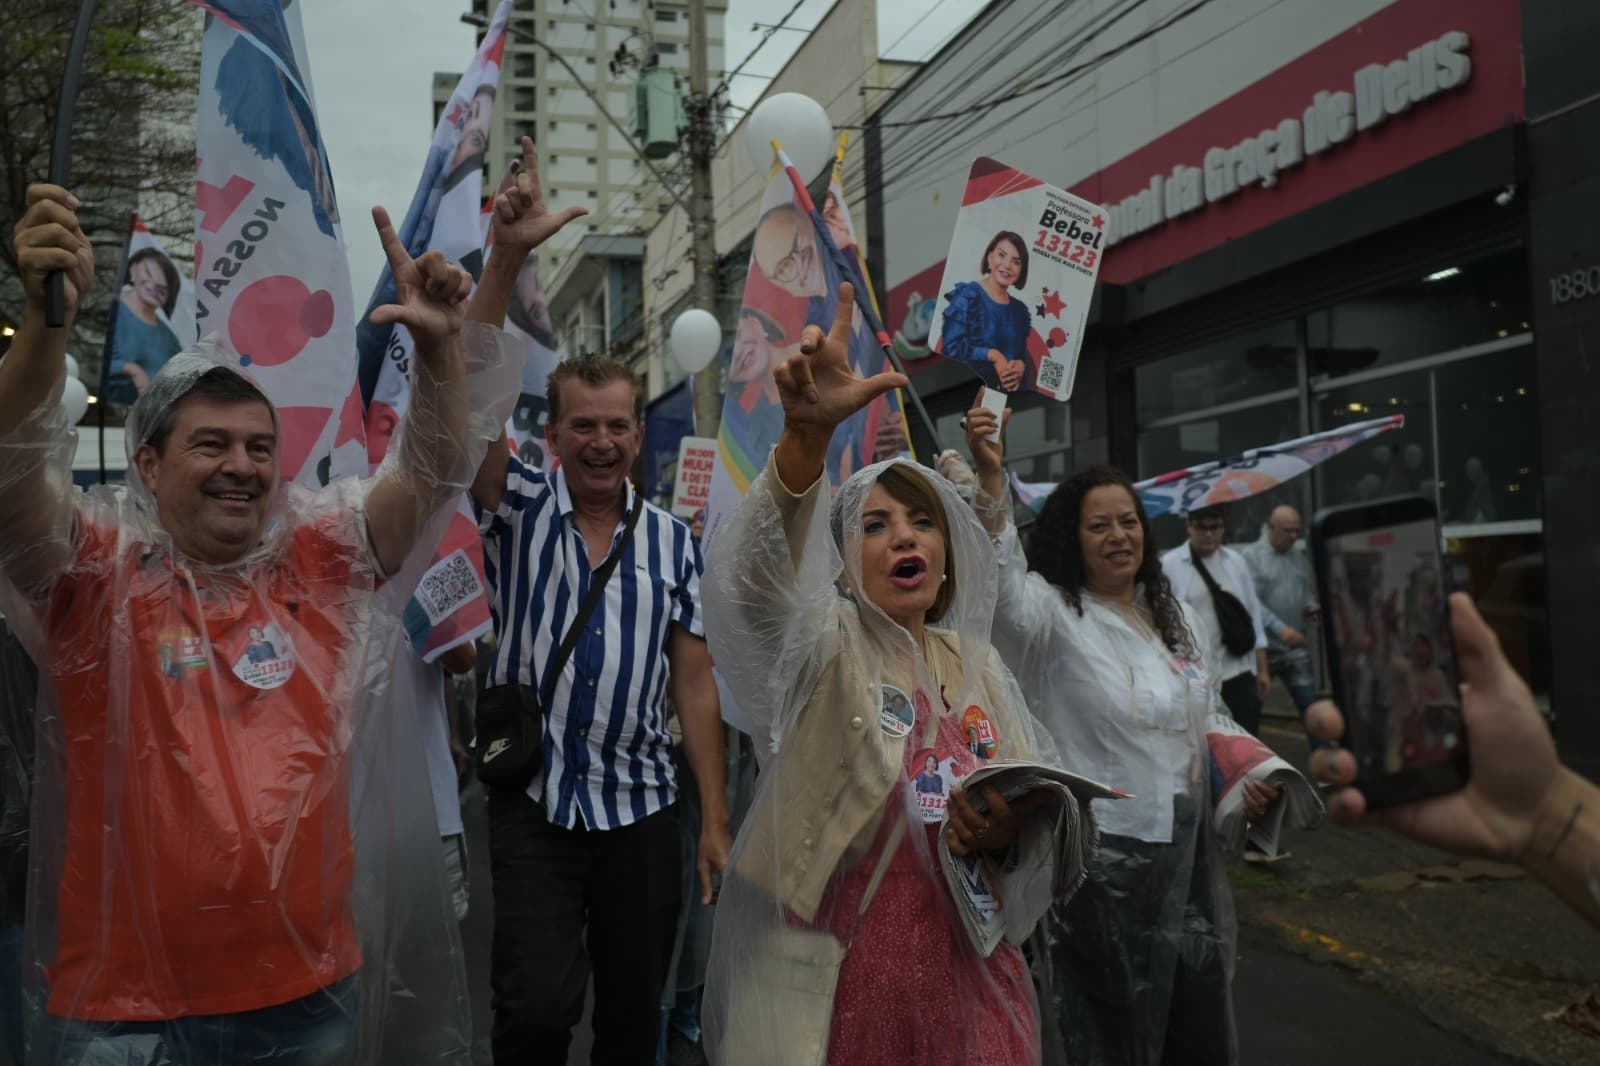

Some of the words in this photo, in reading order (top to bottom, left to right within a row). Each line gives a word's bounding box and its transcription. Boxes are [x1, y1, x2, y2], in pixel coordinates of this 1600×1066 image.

[1203, 117, 1303, 203] Graça
[1302, 89, 1356, 156] de
[1353, 30, 1472, 132] Deus
[1039, 209, 1102, 250] Bebel
[1047, 200, 1090, 225] Professora
[1034, 229, 1097, 268] 13123
[1549, 265, 1600, 304] 1880
